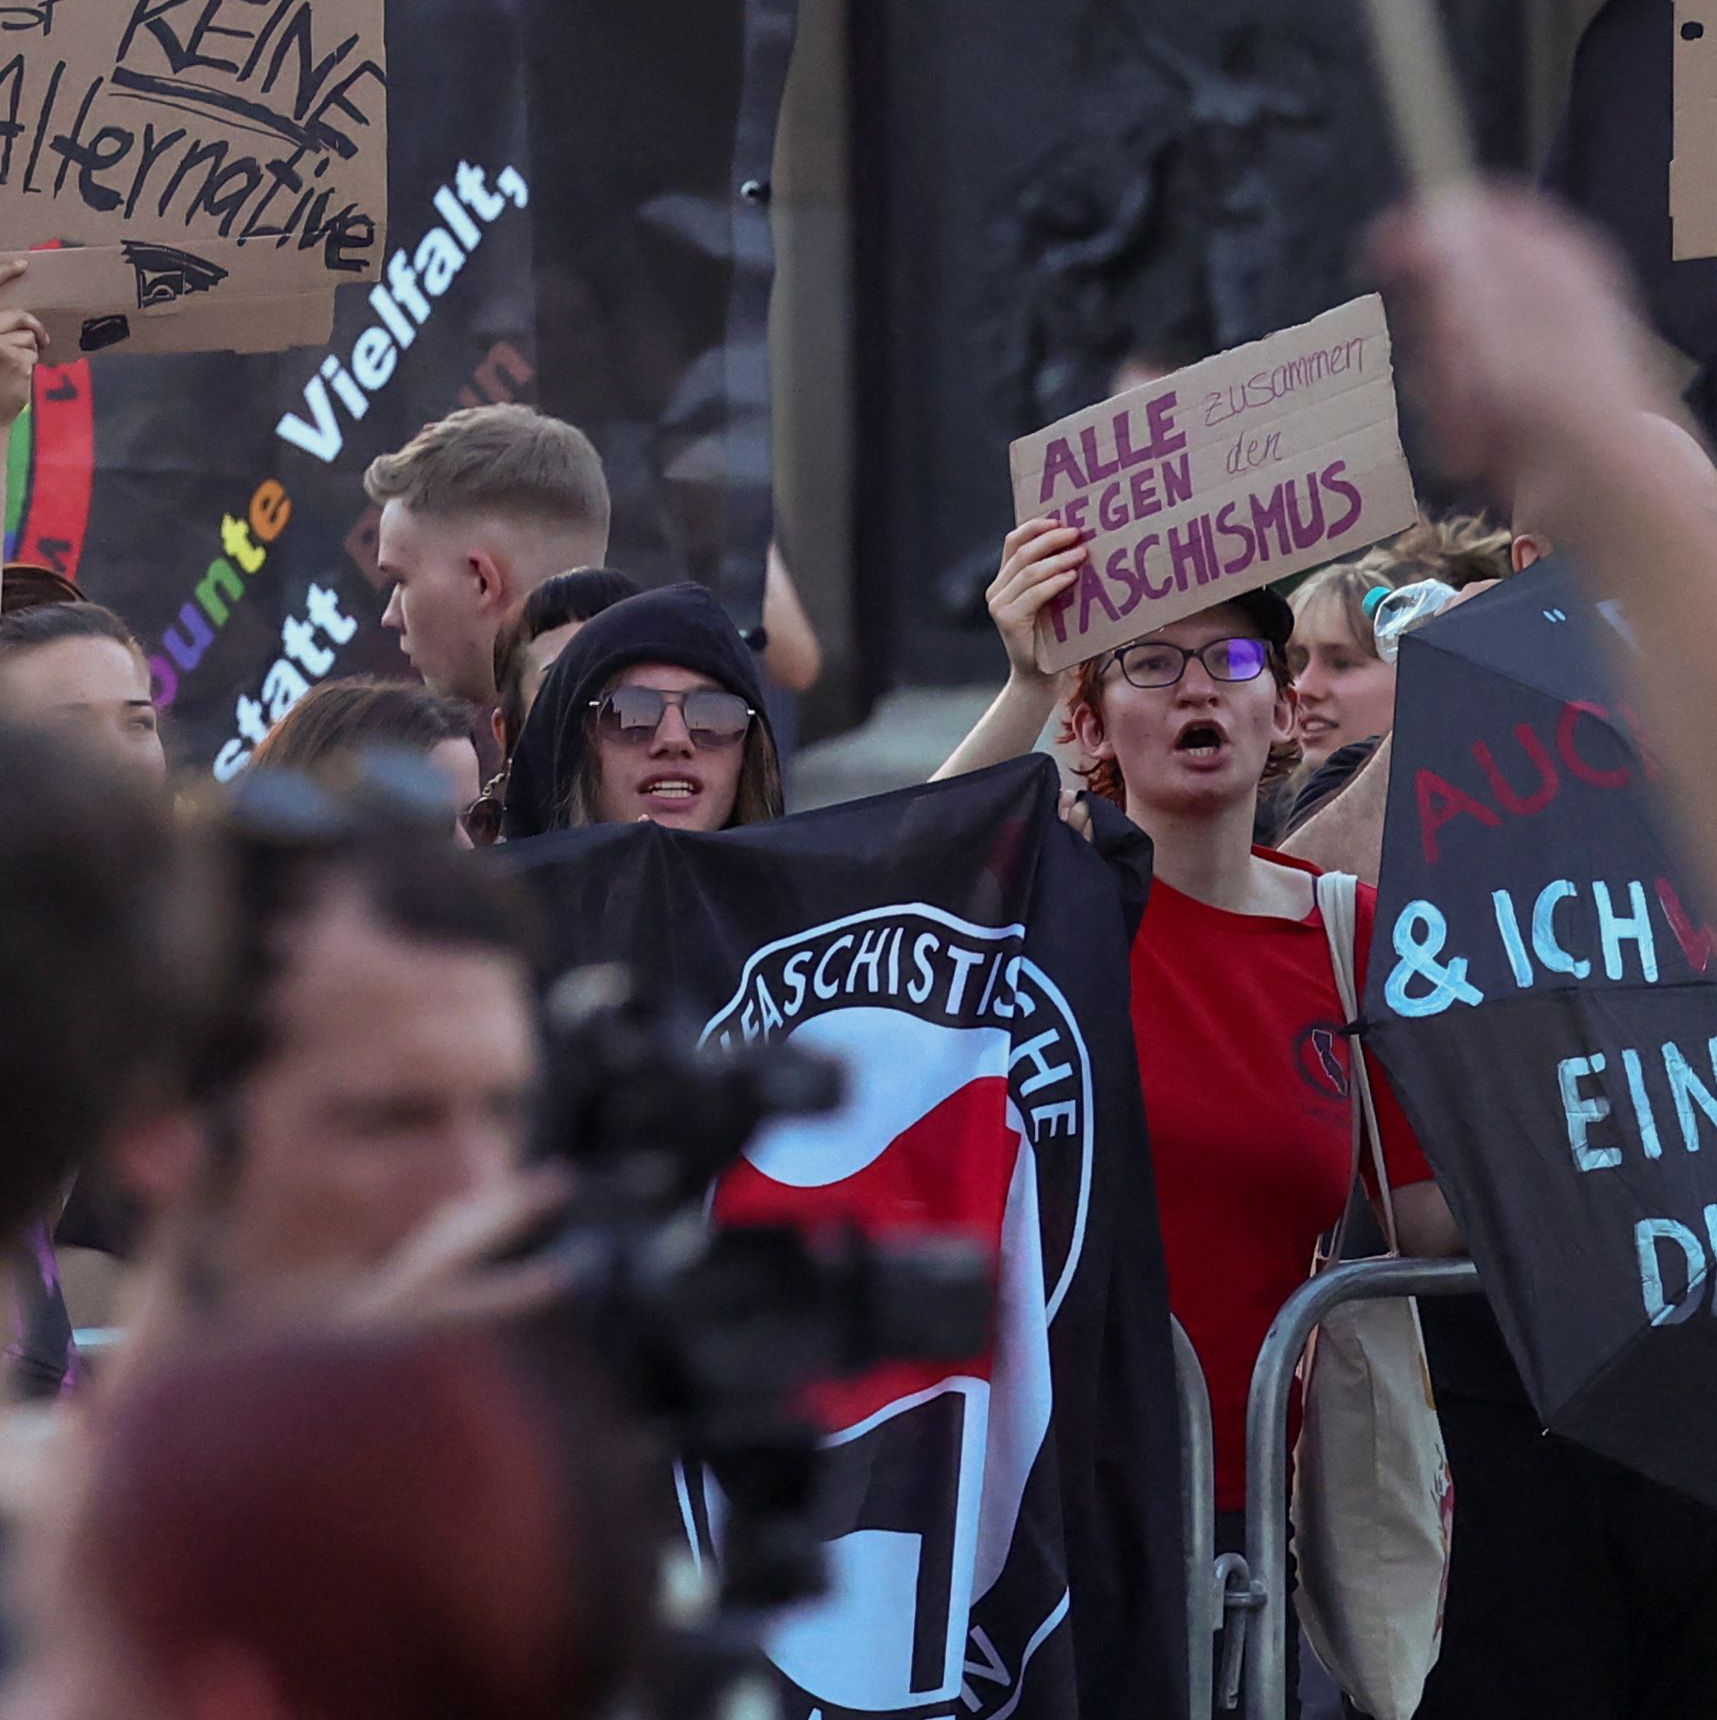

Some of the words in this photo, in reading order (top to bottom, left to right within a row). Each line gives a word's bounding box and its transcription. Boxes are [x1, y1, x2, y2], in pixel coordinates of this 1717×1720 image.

[276, 157, 530, 467] Vielfalt,
[1039, 390, 1187, 504] ALLE
[1204, 336, 1368, 427] zusammen
[1225, 430, 1283, 475] den
[212, 583, 359, 782] statt
[1414, 697, 1662, 866] AUC
[1384, 897, 1485, 1018] &
[1491, 879, 1660, 989] ICH
